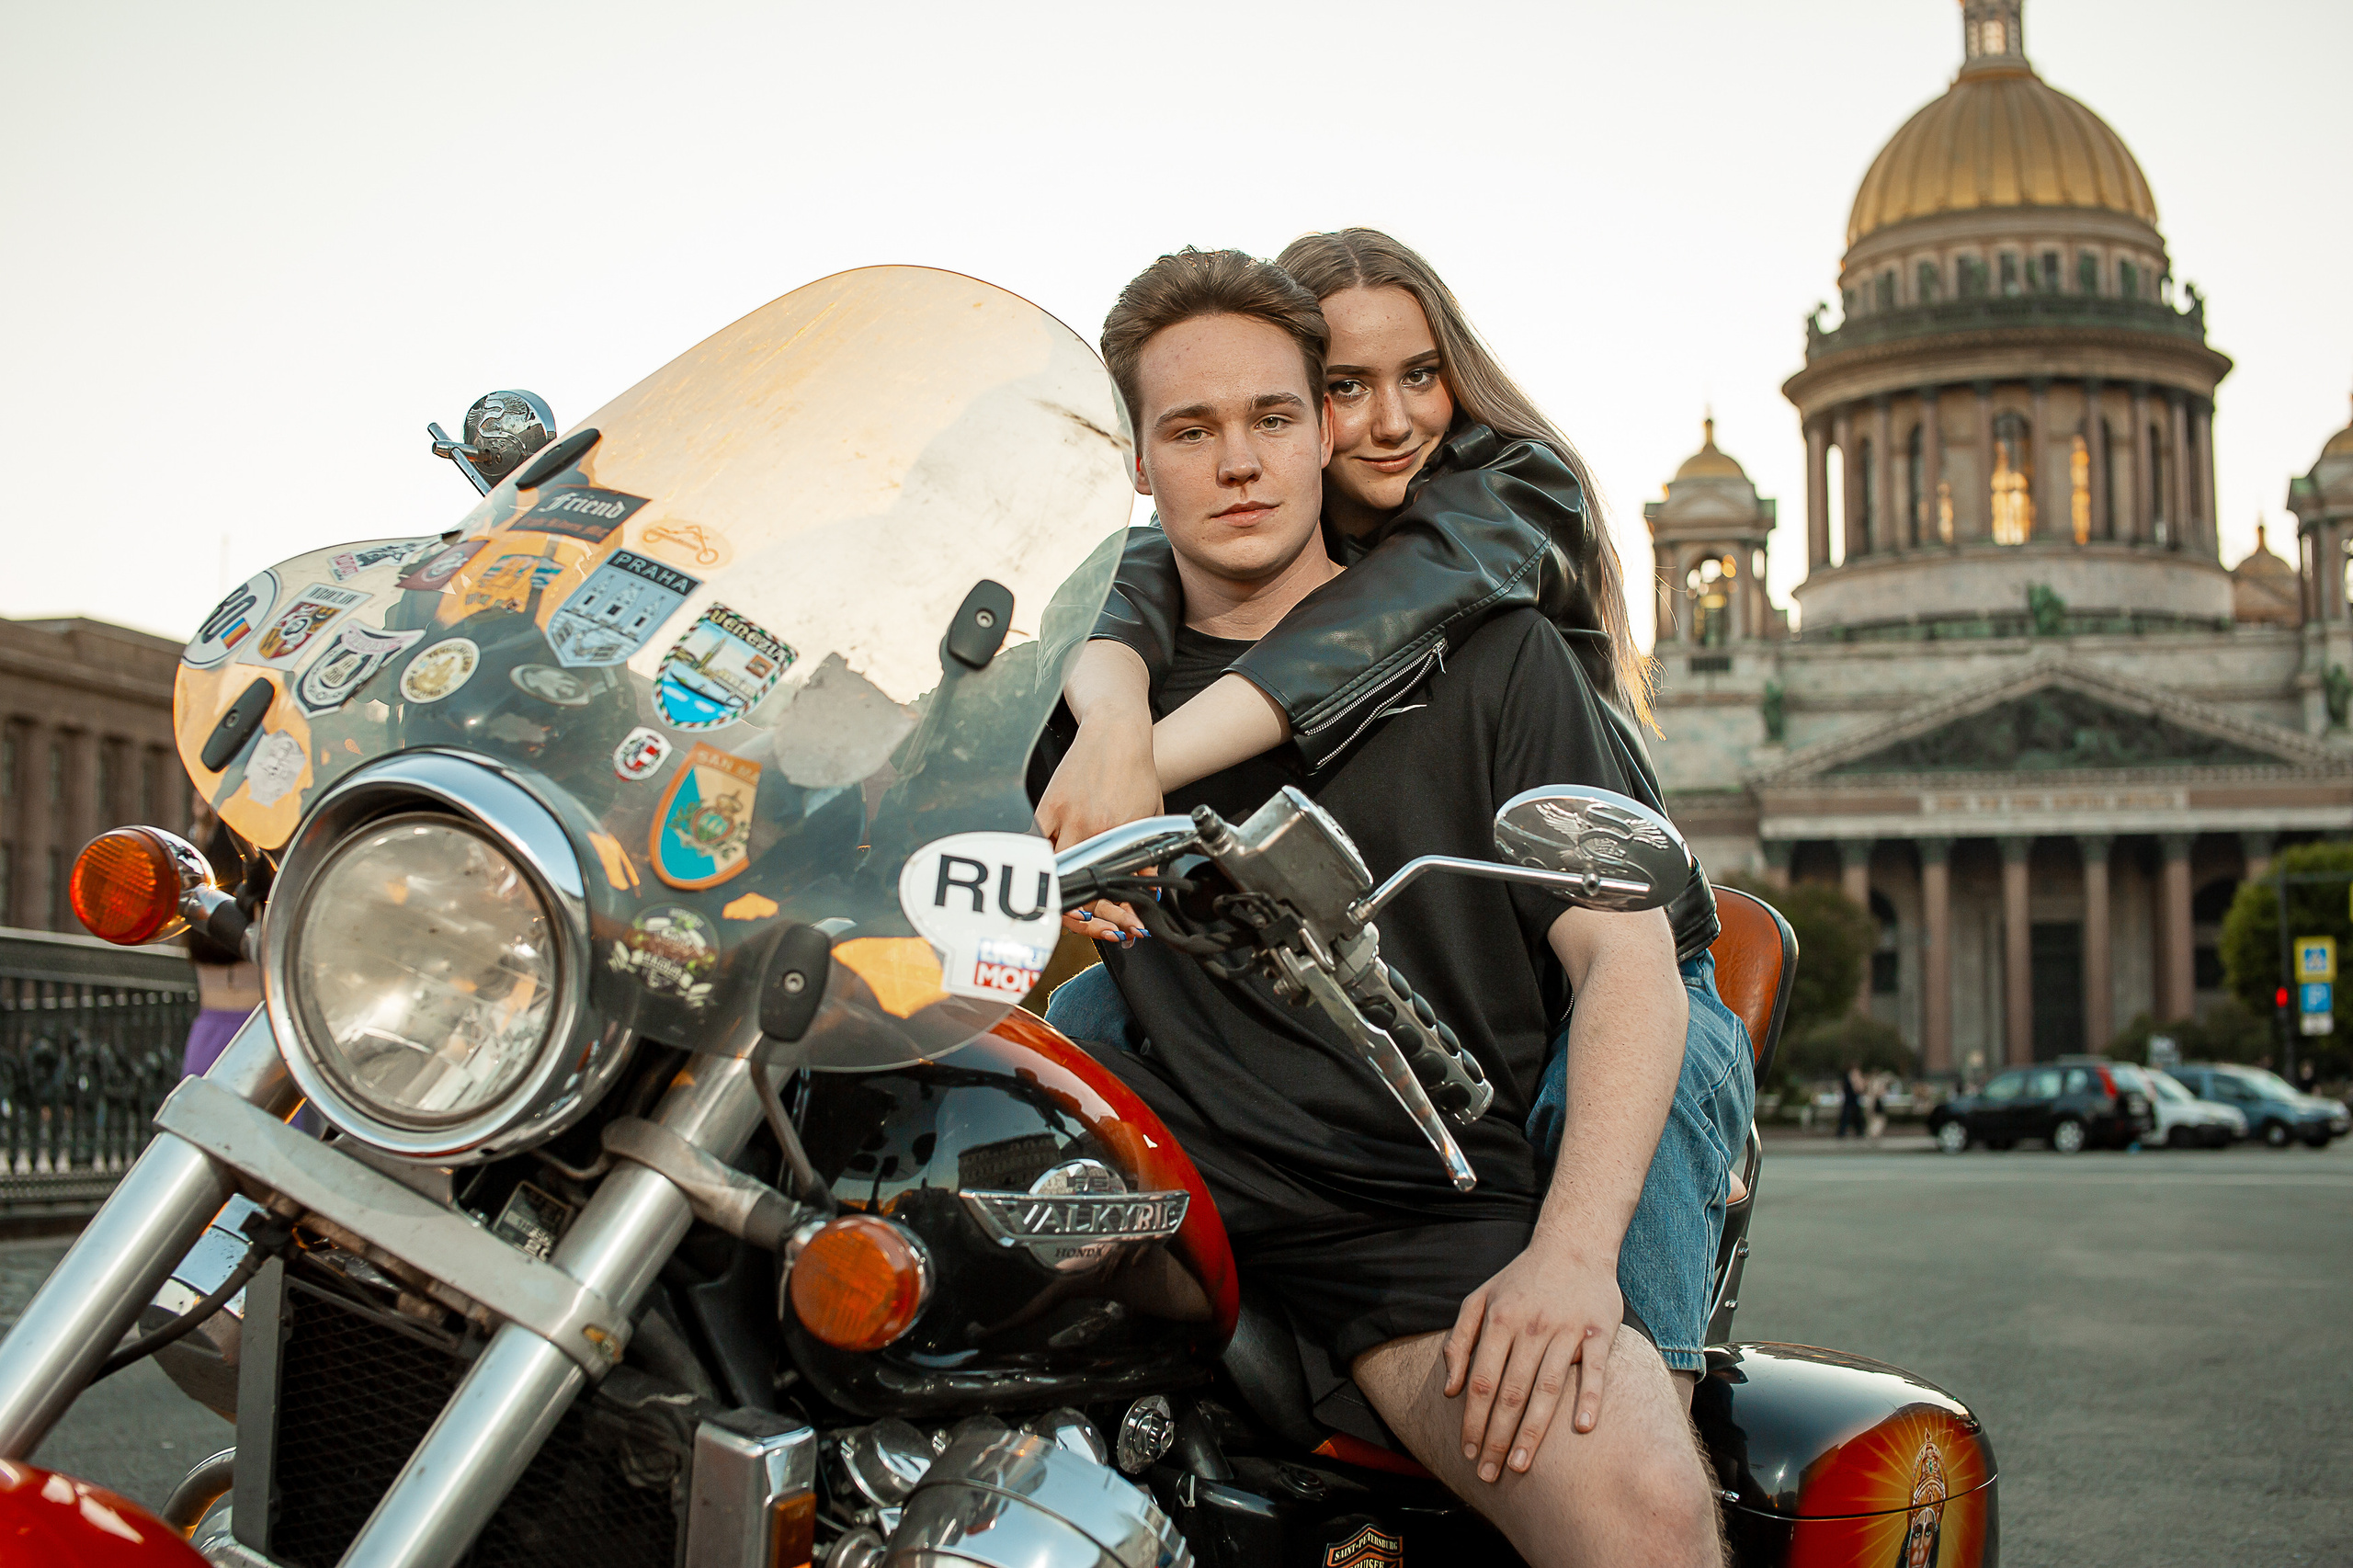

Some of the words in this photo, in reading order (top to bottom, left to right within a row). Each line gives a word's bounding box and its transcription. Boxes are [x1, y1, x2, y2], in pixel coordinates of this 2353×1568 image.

[612, 552, 689, 594] PRAHA
[697, 750, 734, 772] SAN
[934, 853, 1051, 921] RU
[994, 1199, 1178, 1233] VALKYRIE
[1335, 1531, 1398, 1562] SAINT-PETERSBURG
